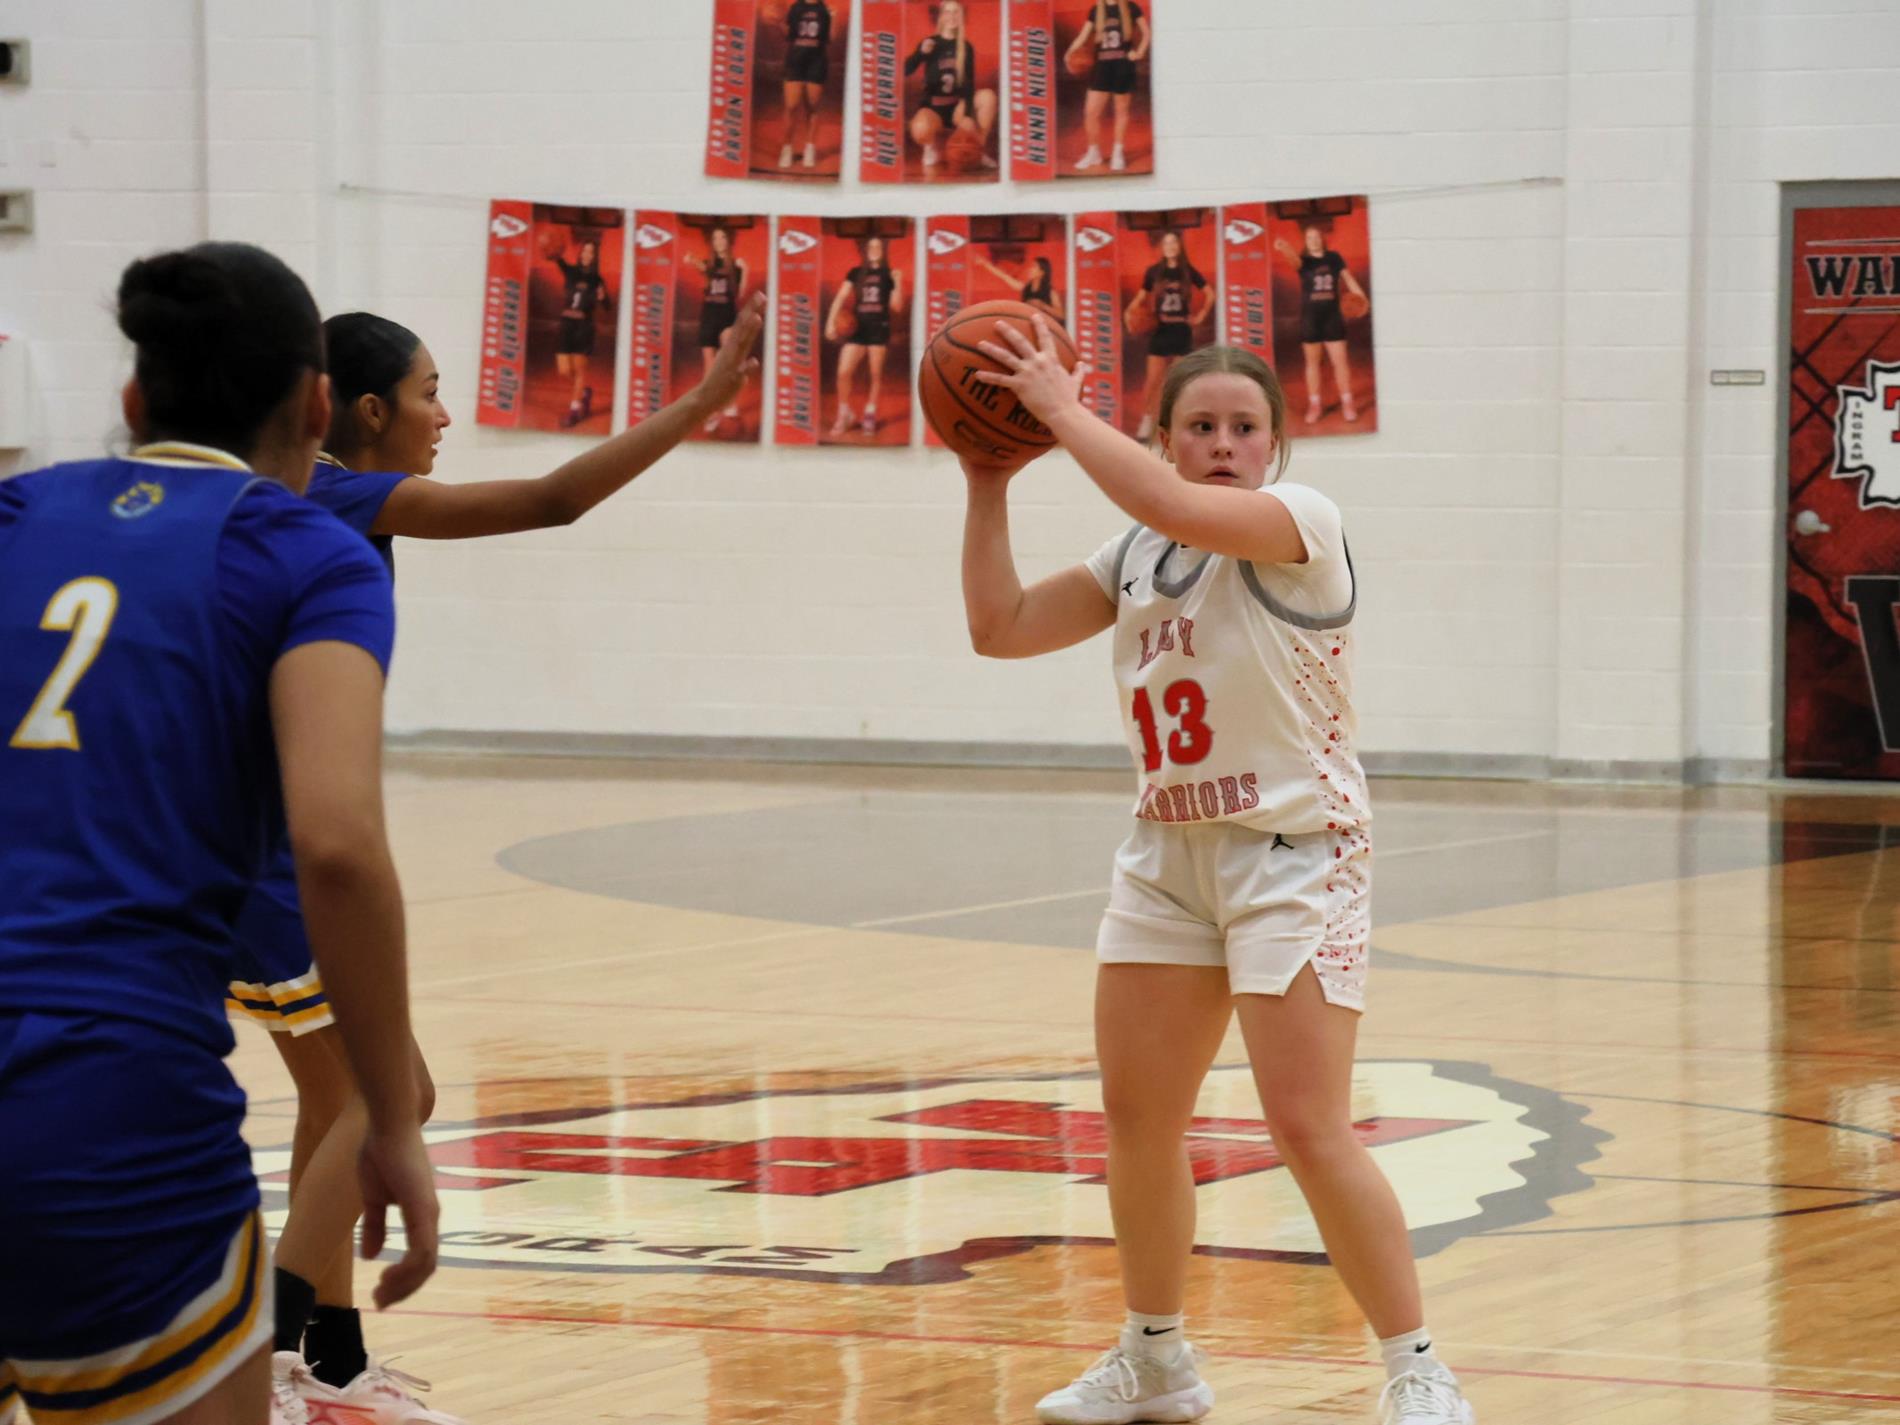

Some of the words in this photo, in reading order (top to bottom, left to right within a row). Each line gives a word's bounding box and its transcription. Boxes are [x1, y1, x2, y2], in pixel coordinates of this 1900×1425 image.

[1026, 27, 1051, 99] NICHOLS
[1803, 254, 1900, 299] WA
[1850, 401, 1864, 460] INGRAM
[8, 576, 119, 750] 2
[1132, 678, 1215, 773] 13
[1136, 773, 1260, 822] ARRIORS
